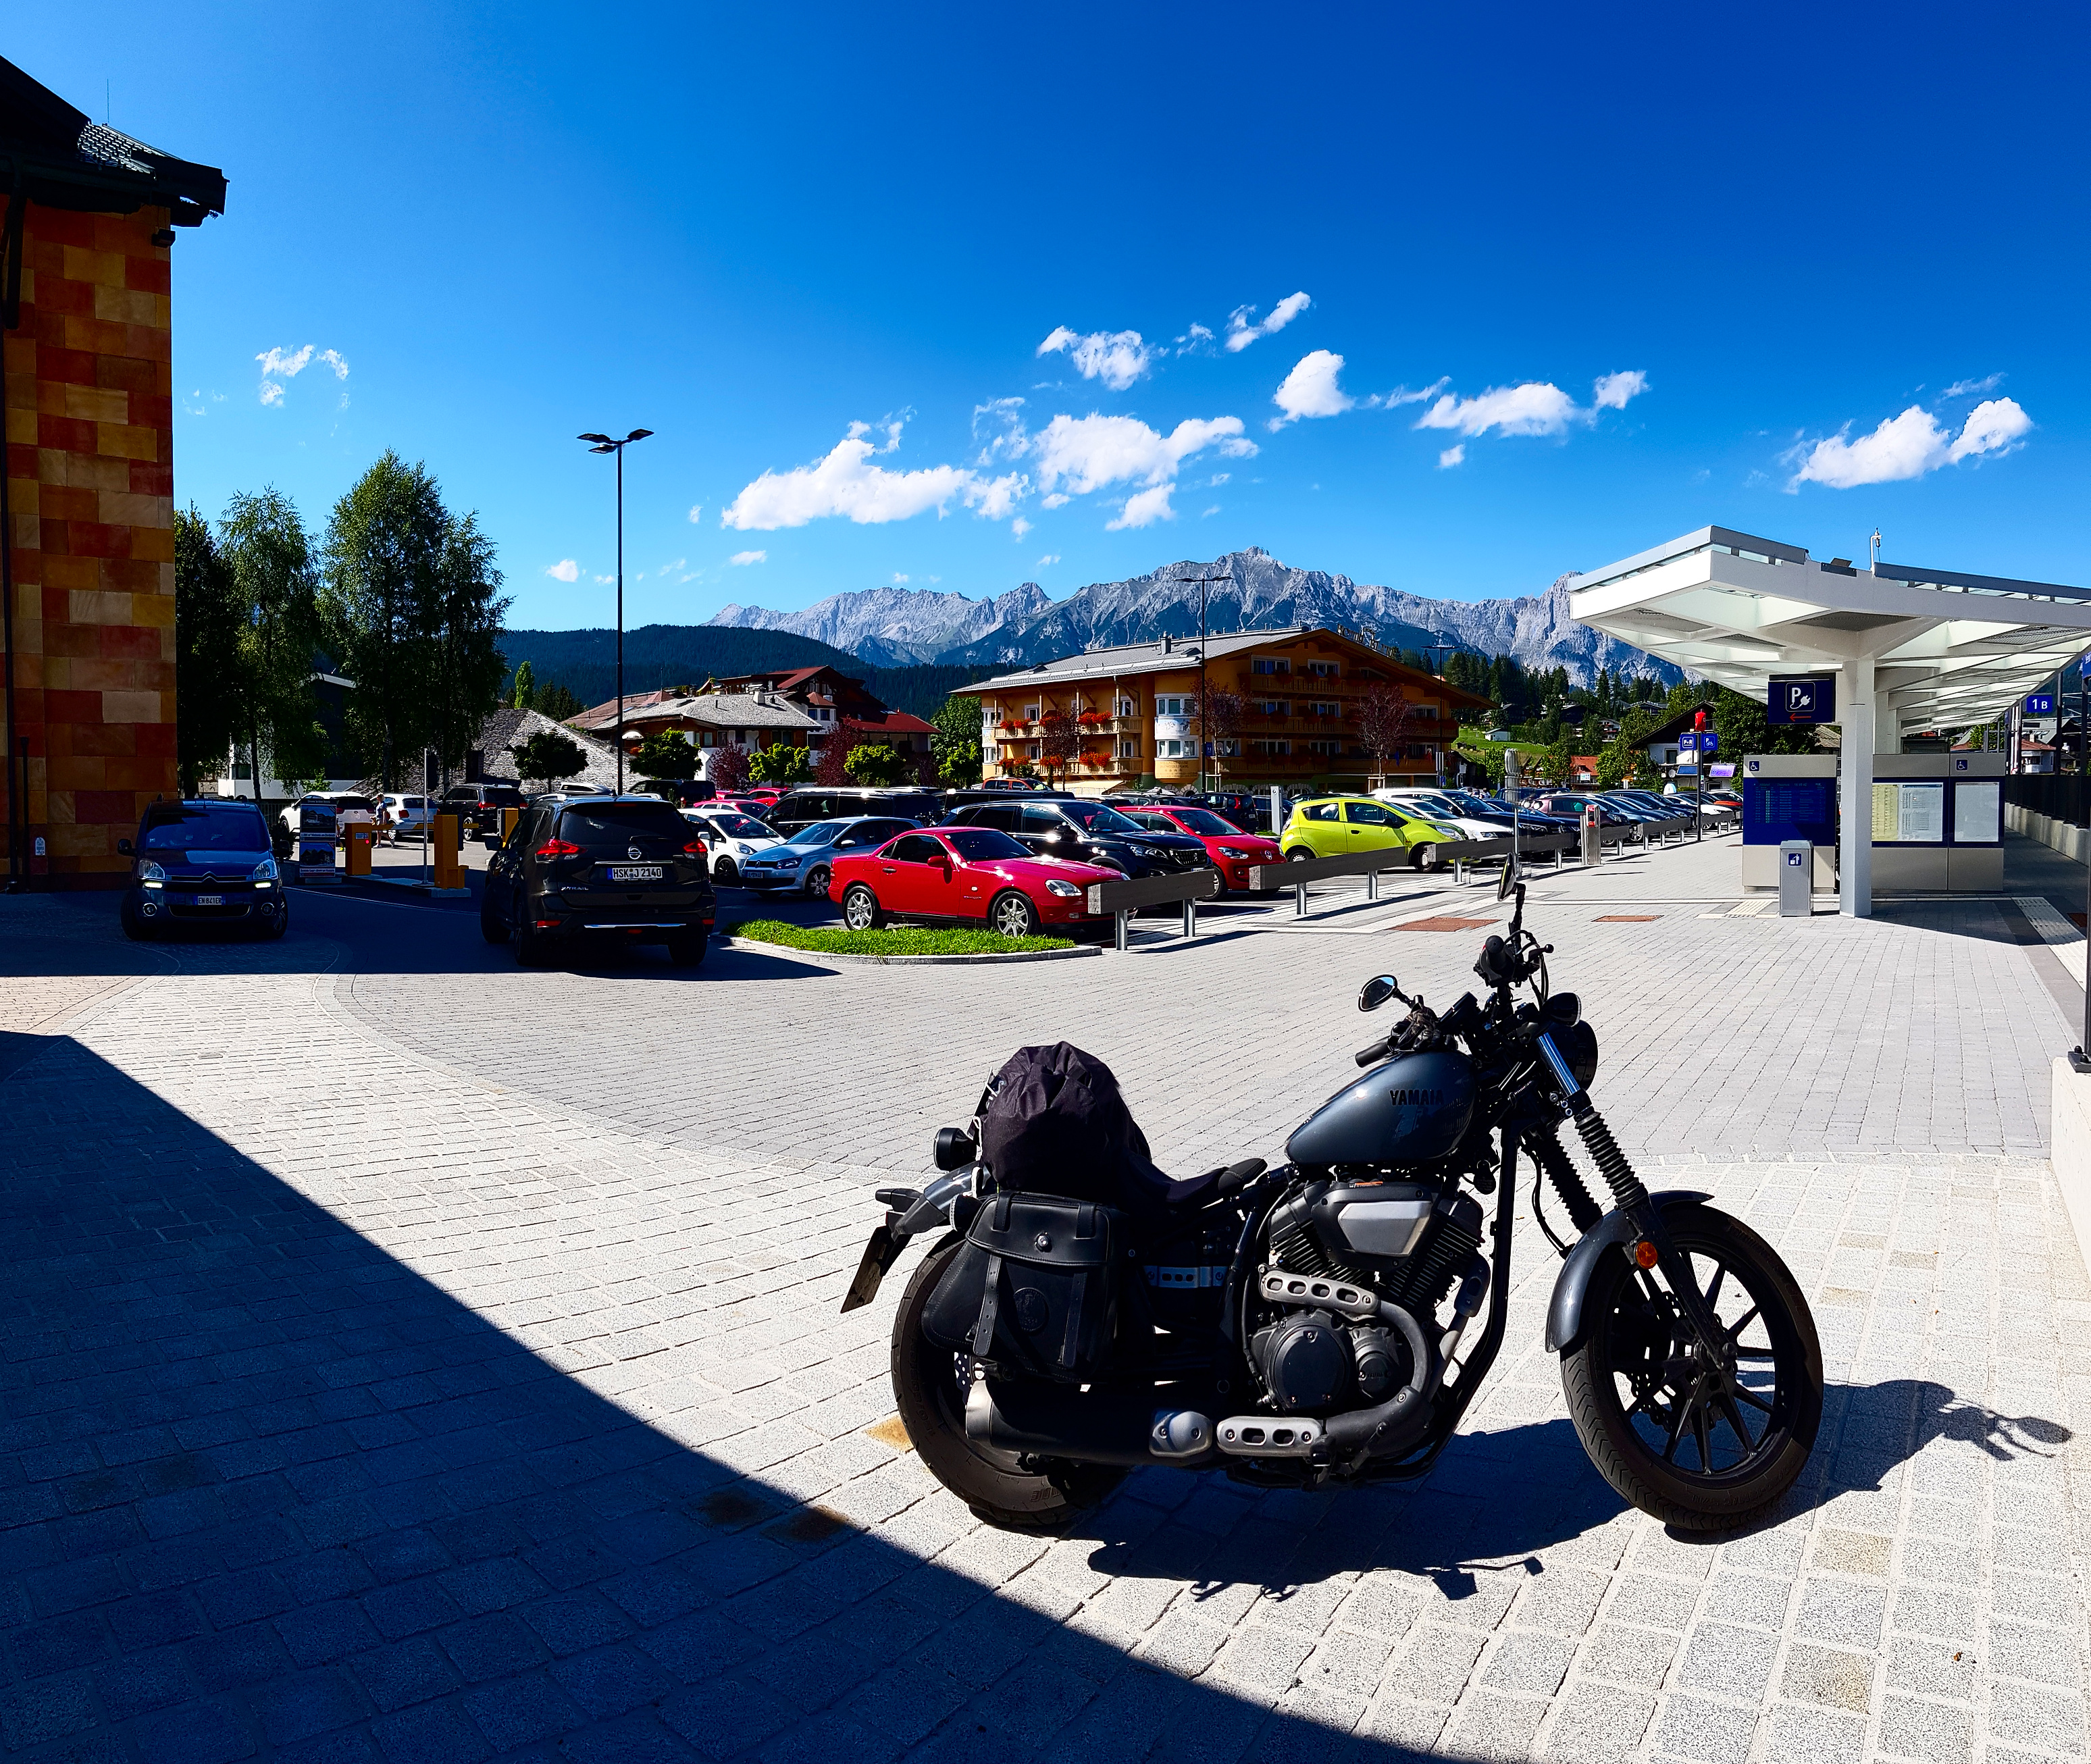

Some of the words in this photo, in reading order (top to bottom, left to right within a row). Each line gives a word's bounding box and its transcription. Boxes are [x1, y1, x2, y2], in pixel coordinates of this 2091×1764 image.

[2032, 698, 2038, 710] 1
[2041, 701, 2048, 709] B
[613, 868, 629, 878] HSK
[634, 868, 639, 877] J
[641, 868, 662, 877] 2140
